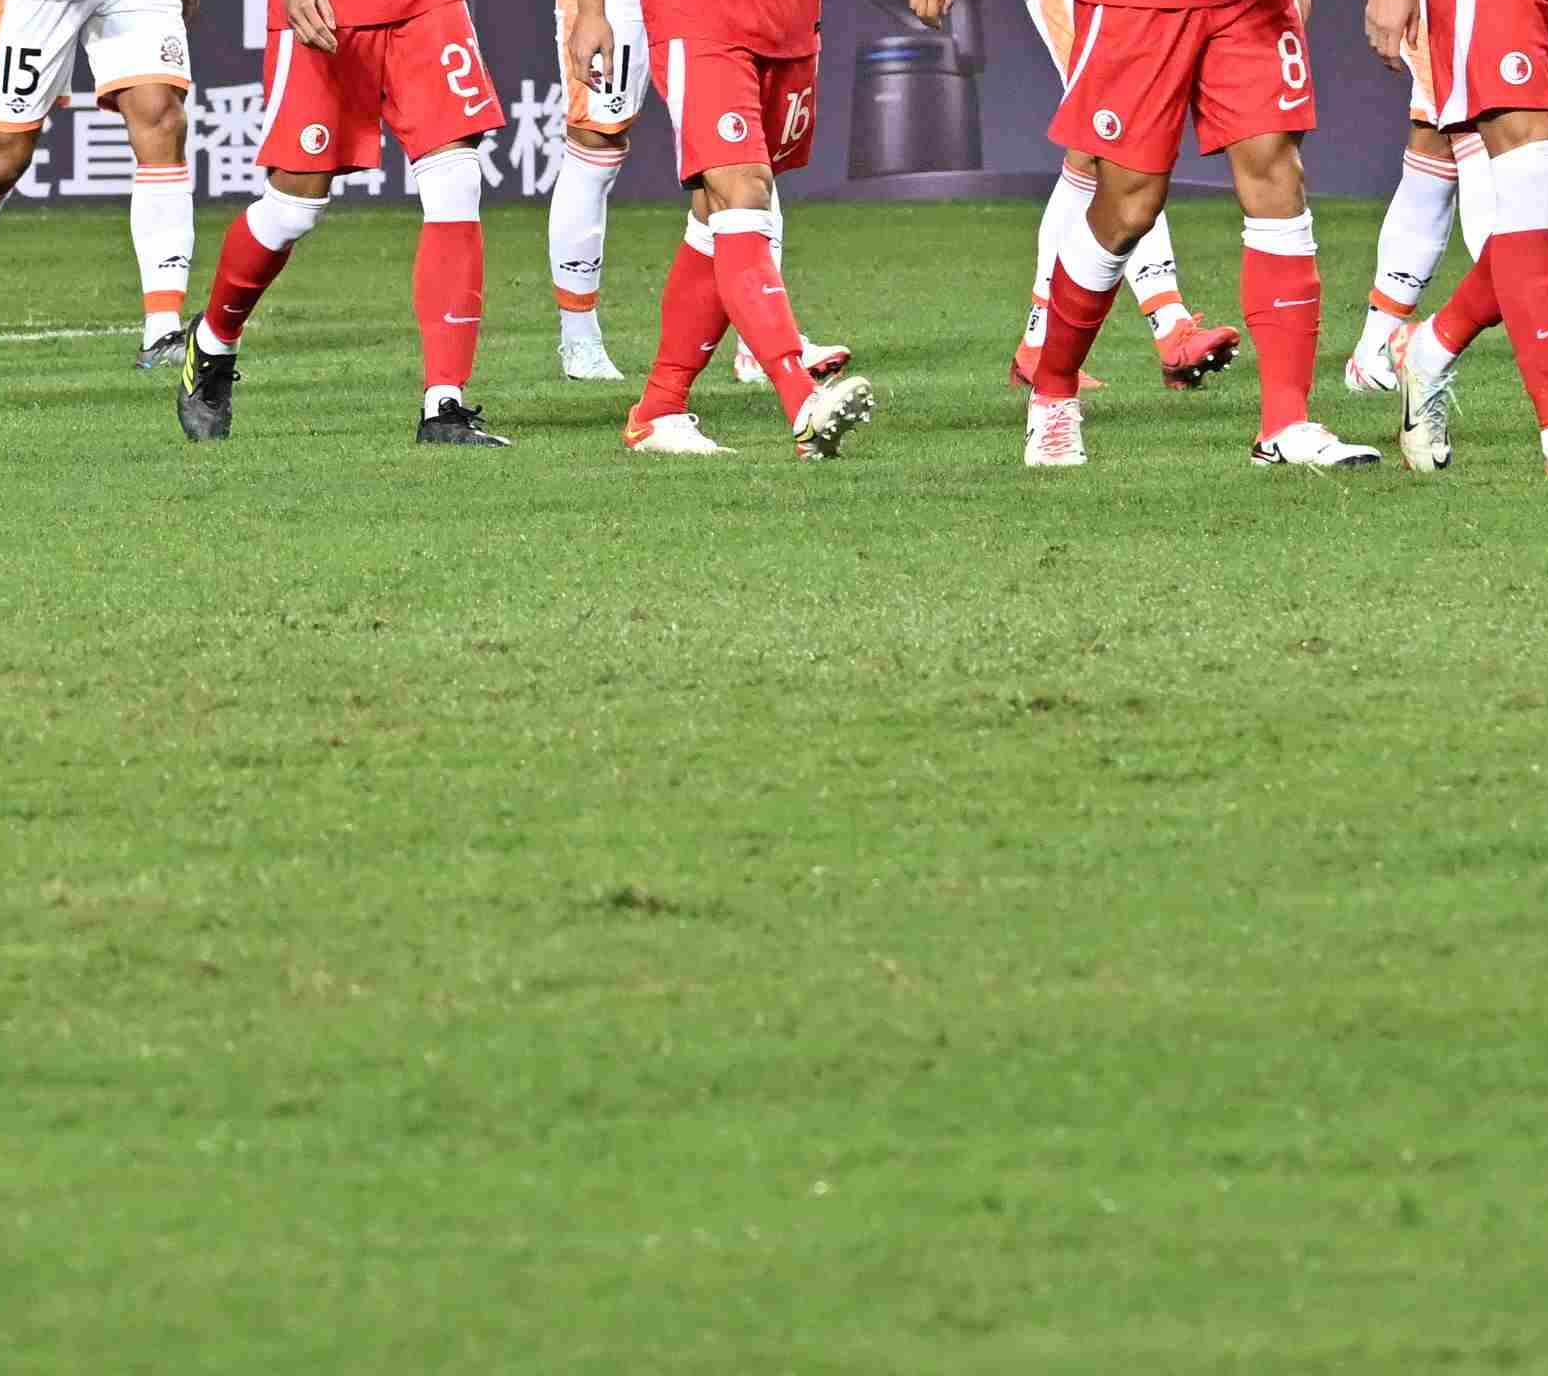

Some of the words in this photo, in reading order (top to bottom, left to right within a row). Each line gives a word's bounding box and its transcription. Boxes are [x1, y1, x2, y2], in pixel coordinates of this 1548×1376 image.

[3, 47, 41, 95] 15
[1278, 32, 1306, 89] 8
[782, 87, 812, 145] 16
